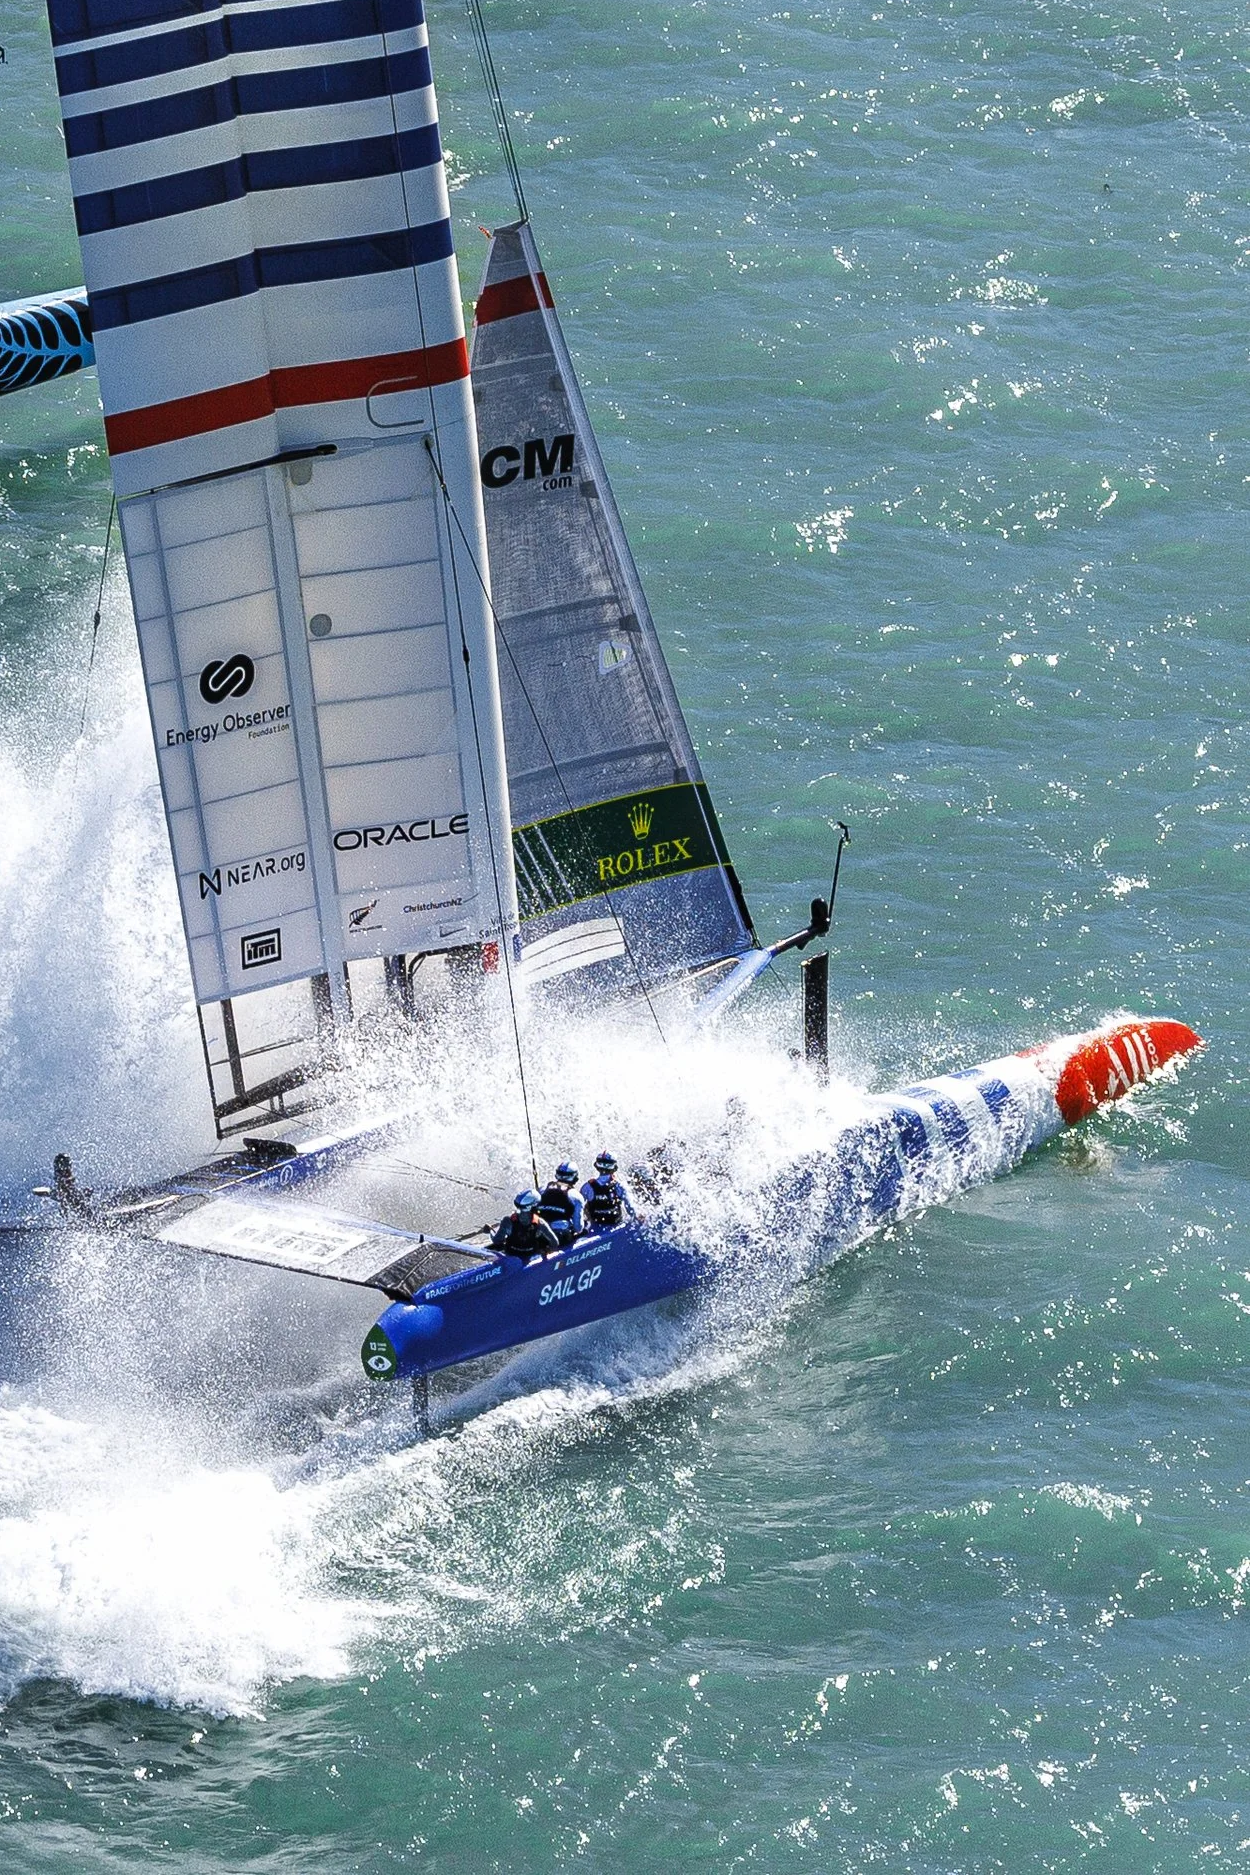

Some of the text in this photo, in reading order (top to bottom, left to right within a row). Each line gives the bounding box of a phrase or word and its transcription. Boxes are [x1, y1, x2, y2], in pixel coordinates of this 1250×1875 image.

[542, 475, 573, 492] com
[166, 703, 291, 746] Energy Observer
[248, 724, 290, 739] Foundation
[333, 813, 470, 851] ORACLE
[227, 850, 306, 888] NEAR.org
[597, 837, 693, 881] ROLEX
[403, 898, 463, 914] ChristchurchNZ
